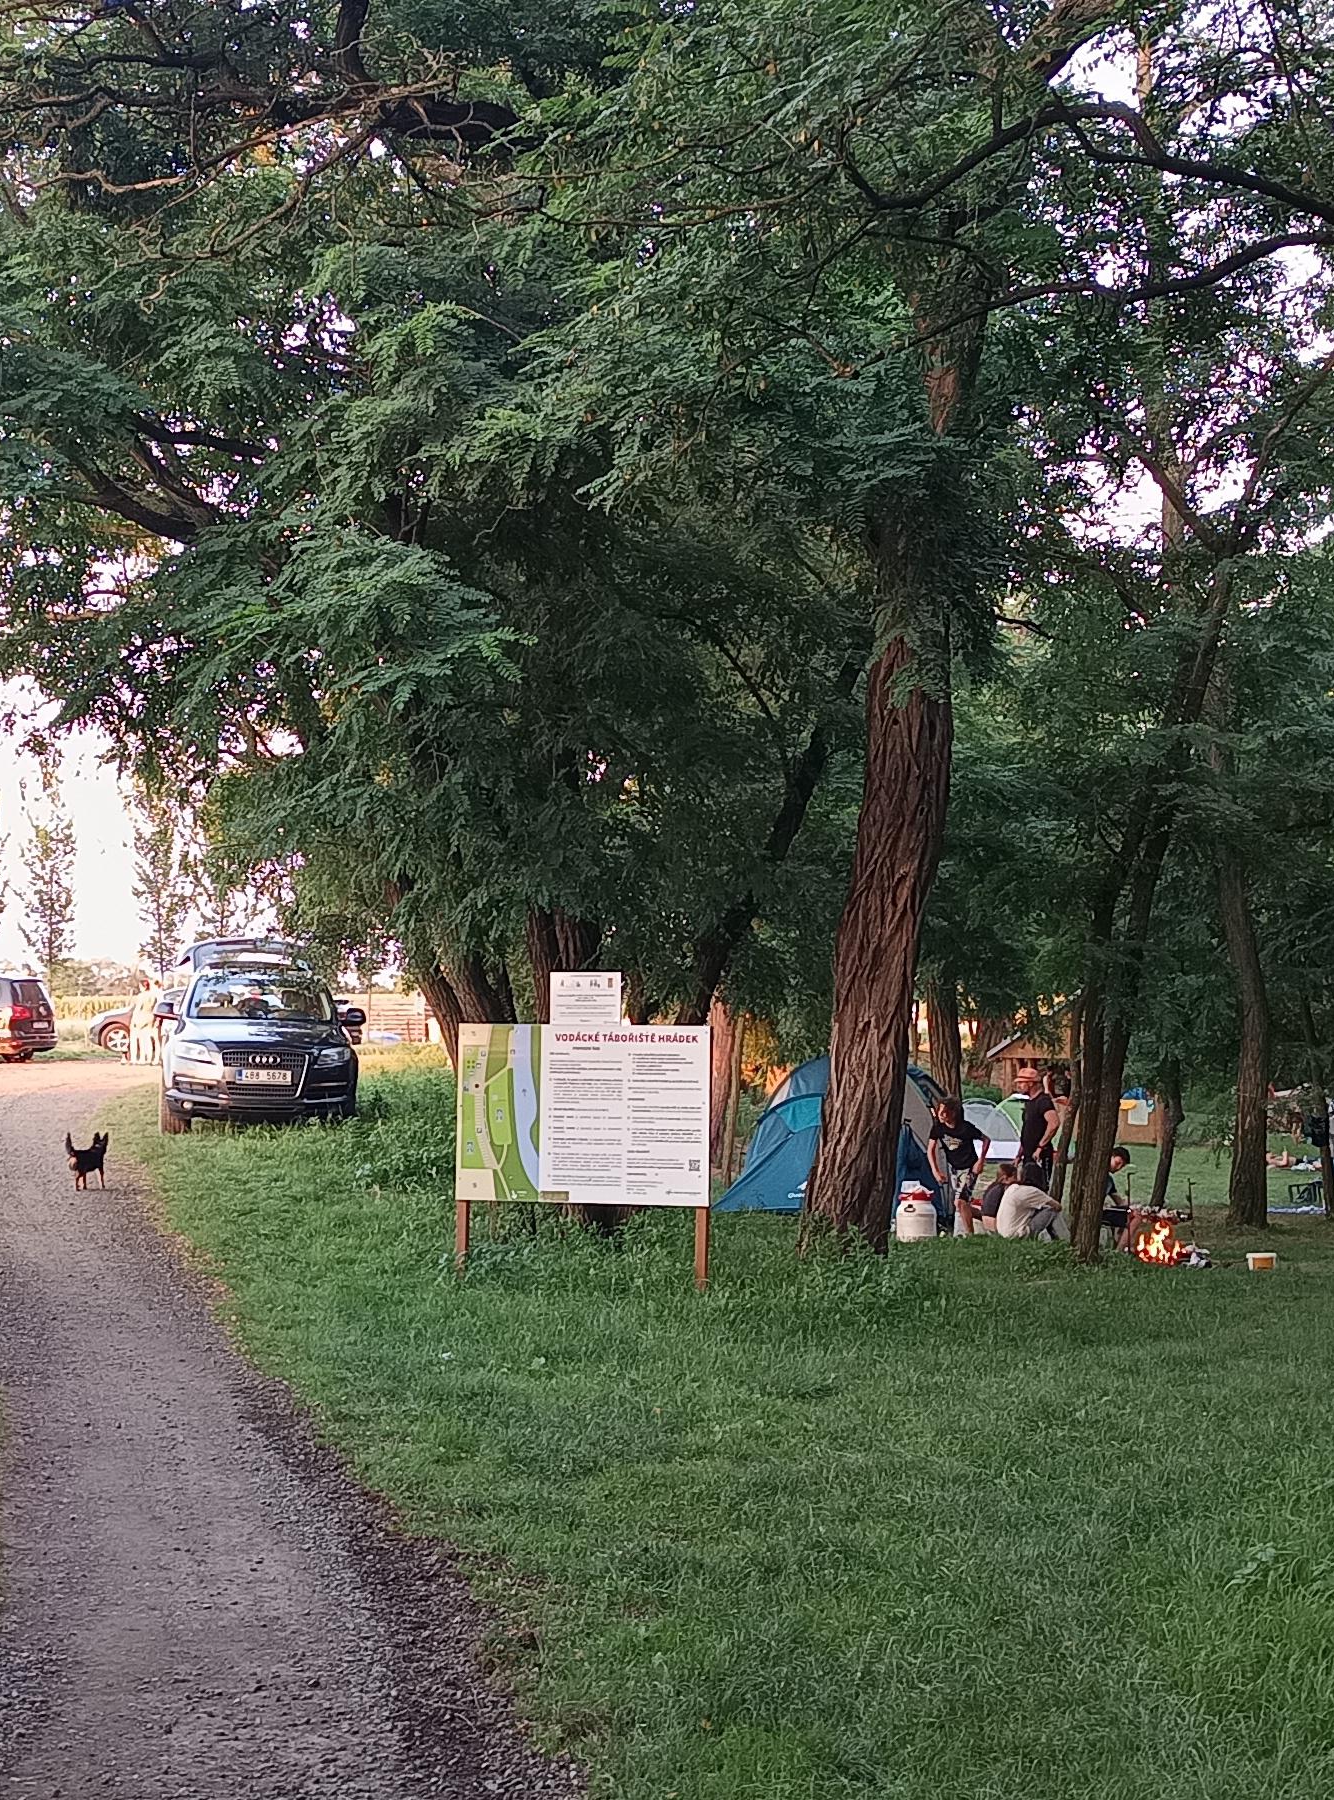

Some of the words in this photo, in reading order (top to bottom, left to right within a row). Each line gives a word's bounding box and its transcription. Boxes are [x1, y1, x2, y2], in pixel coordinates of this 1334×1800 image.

[555, 1031, 600, 1042] VODÁCKÉ
[602, 1031, 656, 1043] TÁBOŘIŠTĚ
[658, 1032, 699, 1043] HRÁDEK
[267, 1072, 288, 1080] 5678
